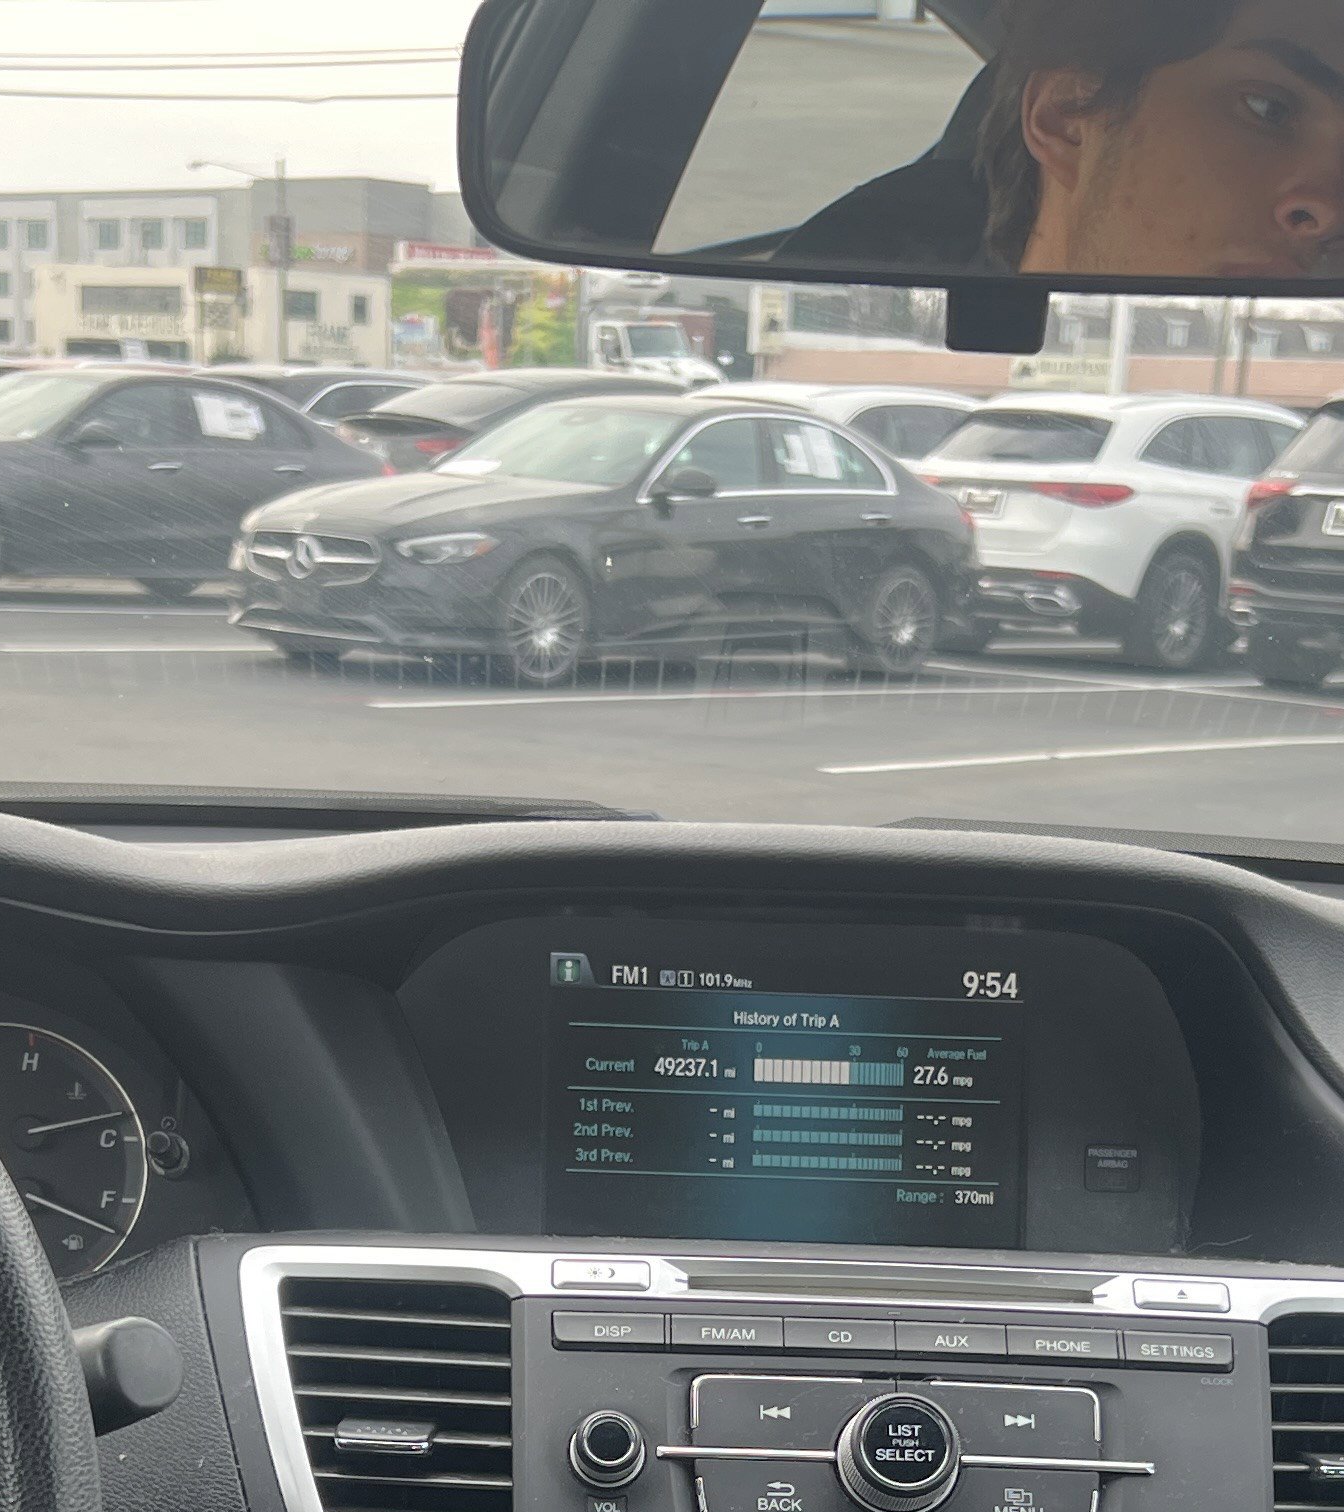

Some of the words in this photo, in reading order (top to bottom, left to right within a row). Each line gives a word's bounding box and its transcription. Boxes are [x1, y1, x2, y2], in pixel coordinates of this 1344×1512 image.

[611, 965, 648, 985] FM1
[962, 971, 1018, 999] 9:54
[733, 1011, 779, 1028] History
[783, 1014, 797, 1026] of
[800, 1013, 826, 1028] Trip
[829, 1015, 840, 1028] A
[681, 1039, 700, 1051] Trip
[701, 1040, 709, 1050] A
[927, 1047, 965, 1060] Average
[967, 1048, 987, 1060] Fuel
[21, 1052, 39, 1071] H
[585, 1057, 635, 1072] Current
[654, 1057, 718, 1077] 49237.1
[724, 1067, 736, 1078] mi
[913, 1066, 949, 1085] 27.6
[952, 1075, 973, 1087] mpg
[579, 1098, 598, 1112] 1st
[601, 1098, 635, 1113] Prev.
[573, 1122, 598, 1137] 2nd
[601, 1123, 634, 1138] Prev.
[100, 1129, 117, 1148] C
[575, 1148, 598, 1162] 3rd
[601, 1148, 634, 1163] Prev.
[100, 1190, 117, 1208] F
[594, 1325, 632, 1338] DISP
[701, 1327, 756, 1341] FM/AM
[827, 1331, 852, 1343] CD
[934, 1335, 969, 1348] AUX
[1035, 1340, 1091, 1353] PHONE
[1140, 1344, 1214, 1359] SETTINGS
[1200, 1377, 1233, 1386] CLOCK
[888, 1424, 922, 1437] LIST
[892, 1439, 919, 1447] PUSH
[875, 1449, 935, 1462] SELECT
[594, 1502, 621, 1512] VOL
[757, 1498, 803, 1512] BACK
